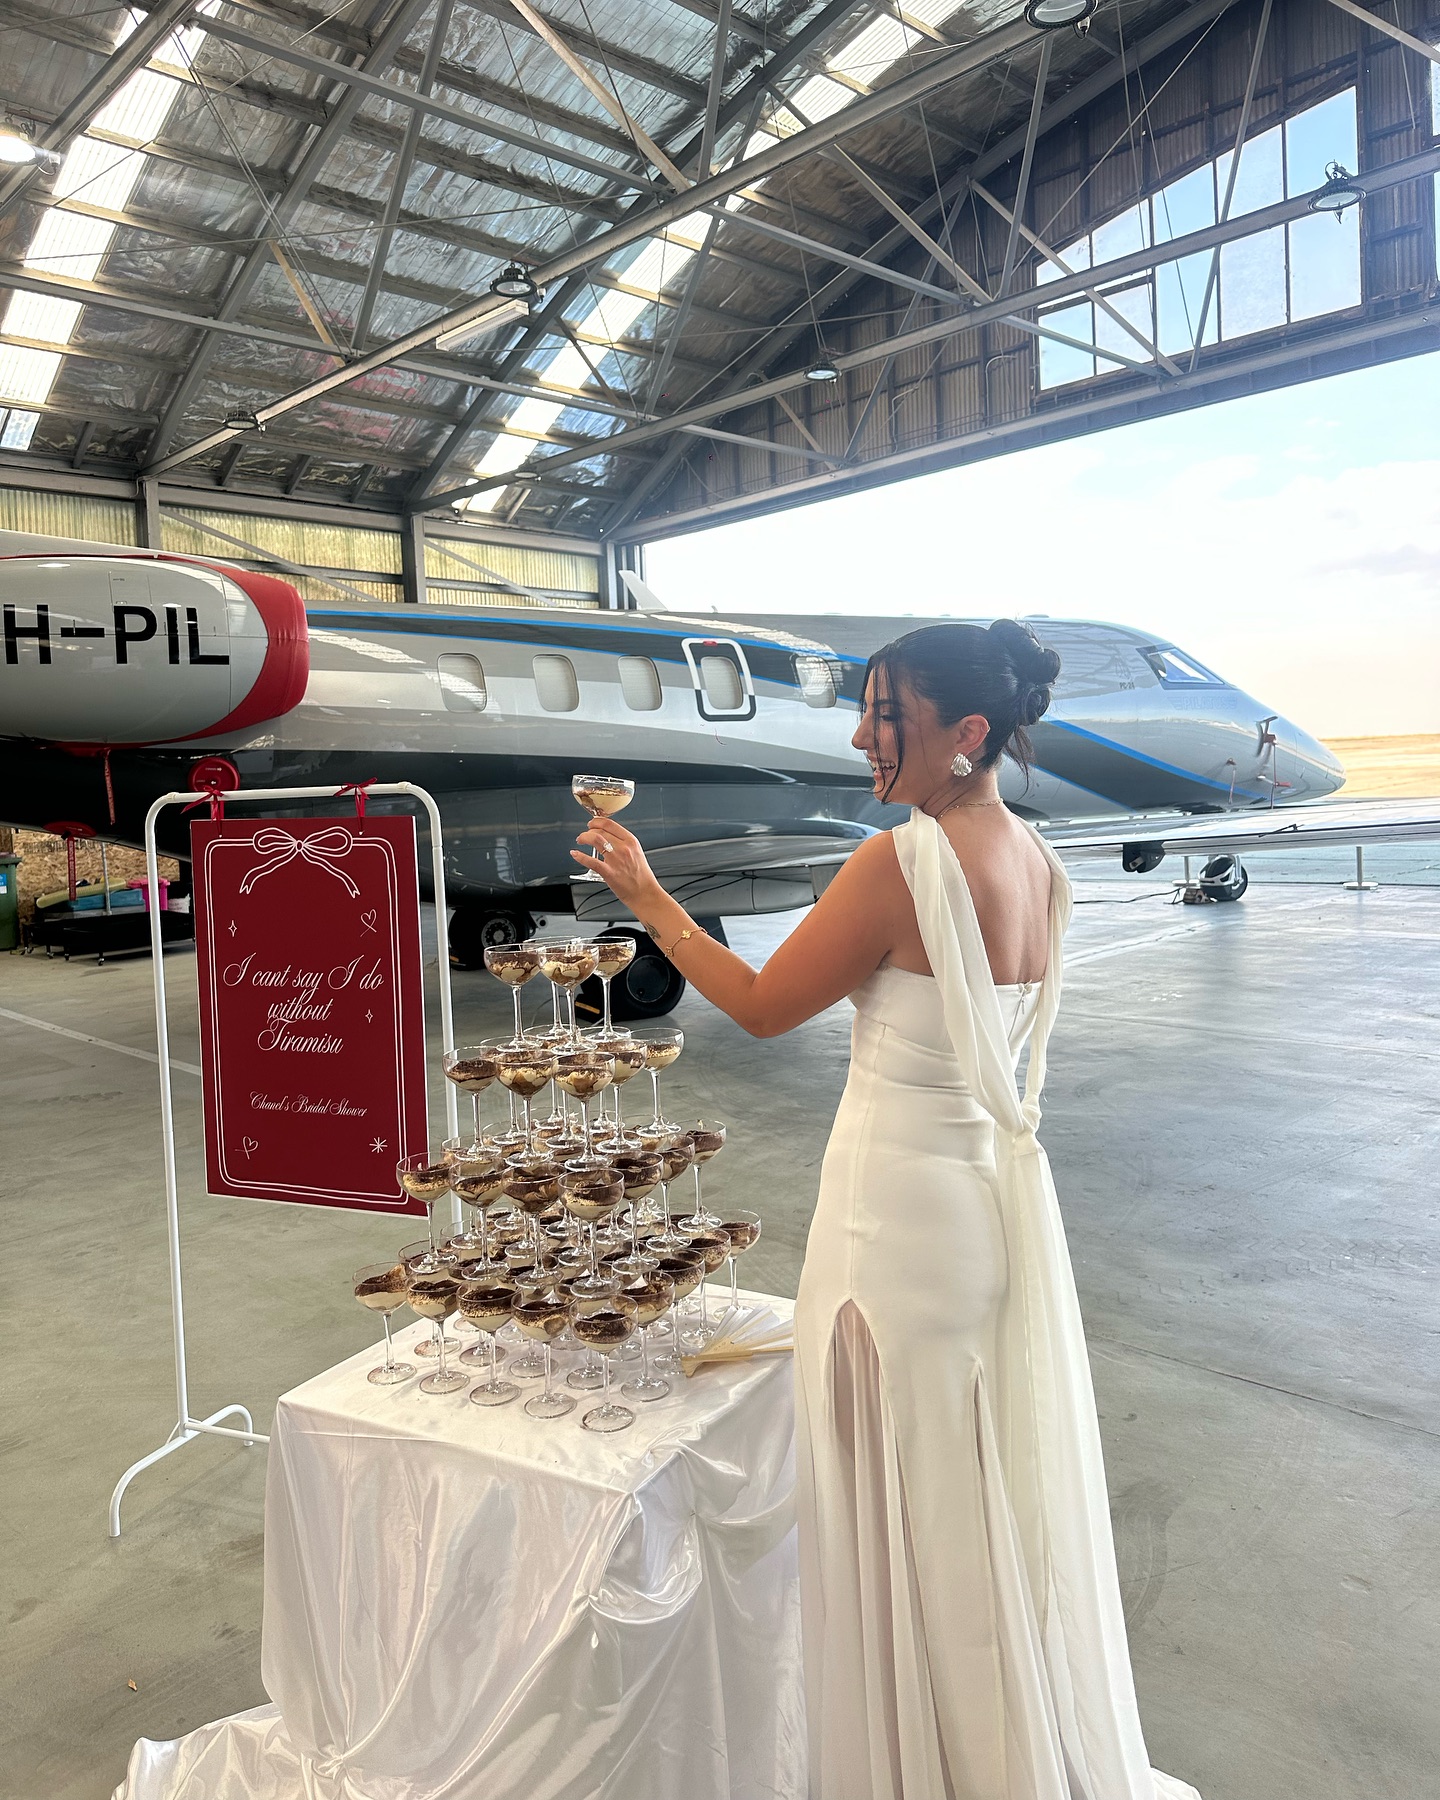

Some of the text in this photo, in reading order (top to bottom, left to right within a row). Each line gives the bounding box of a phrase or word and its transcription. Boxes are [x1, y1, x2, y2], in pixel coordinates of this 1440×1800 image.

[223, 952, 384, 1006] I cant say I do
[267, 988, 334, 1024] without
[257, 1017, 344, 1054] Tiramisu
[291, 1094, 332, 1114] Bridal
[329, 1098, 368, 1117] Shower
